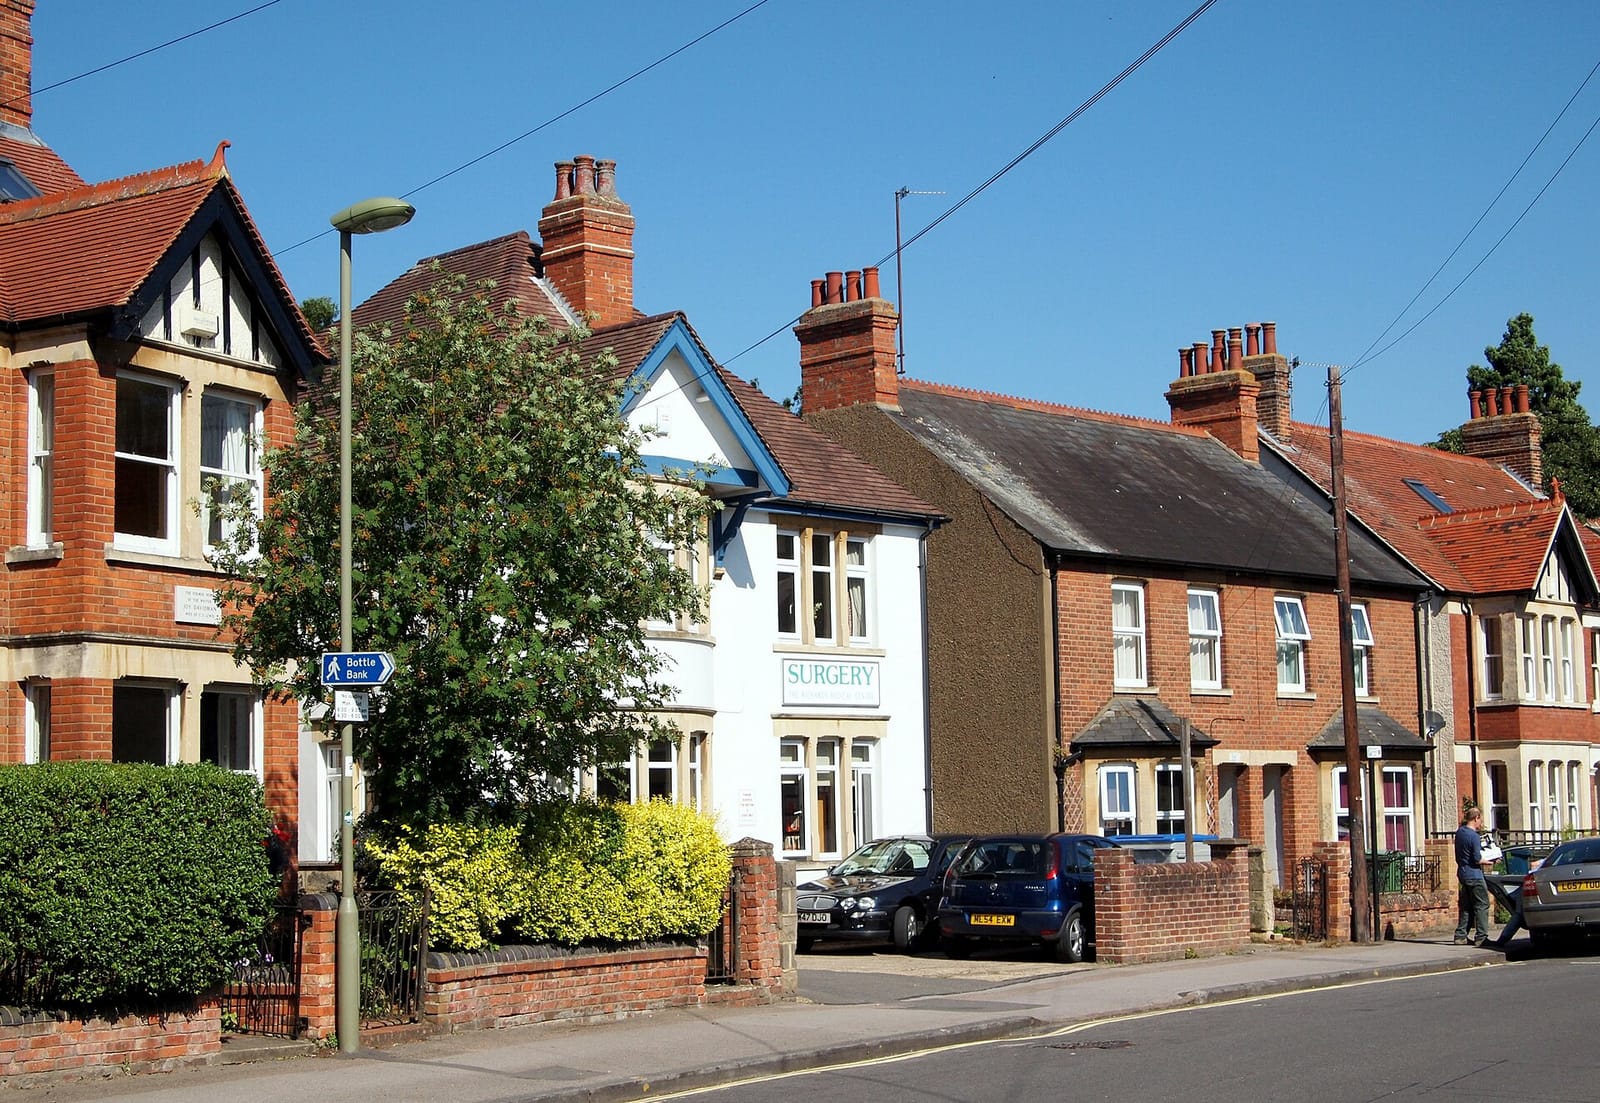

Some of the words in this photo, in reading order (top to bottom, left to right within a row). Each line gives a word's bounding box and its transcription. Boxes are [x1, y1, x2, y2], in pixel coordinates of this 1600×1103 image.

[346, 657, 376, 667] Bottle
[346, 669, 368, 679] Bank
[788, 663, 874, 686] SURGERY
